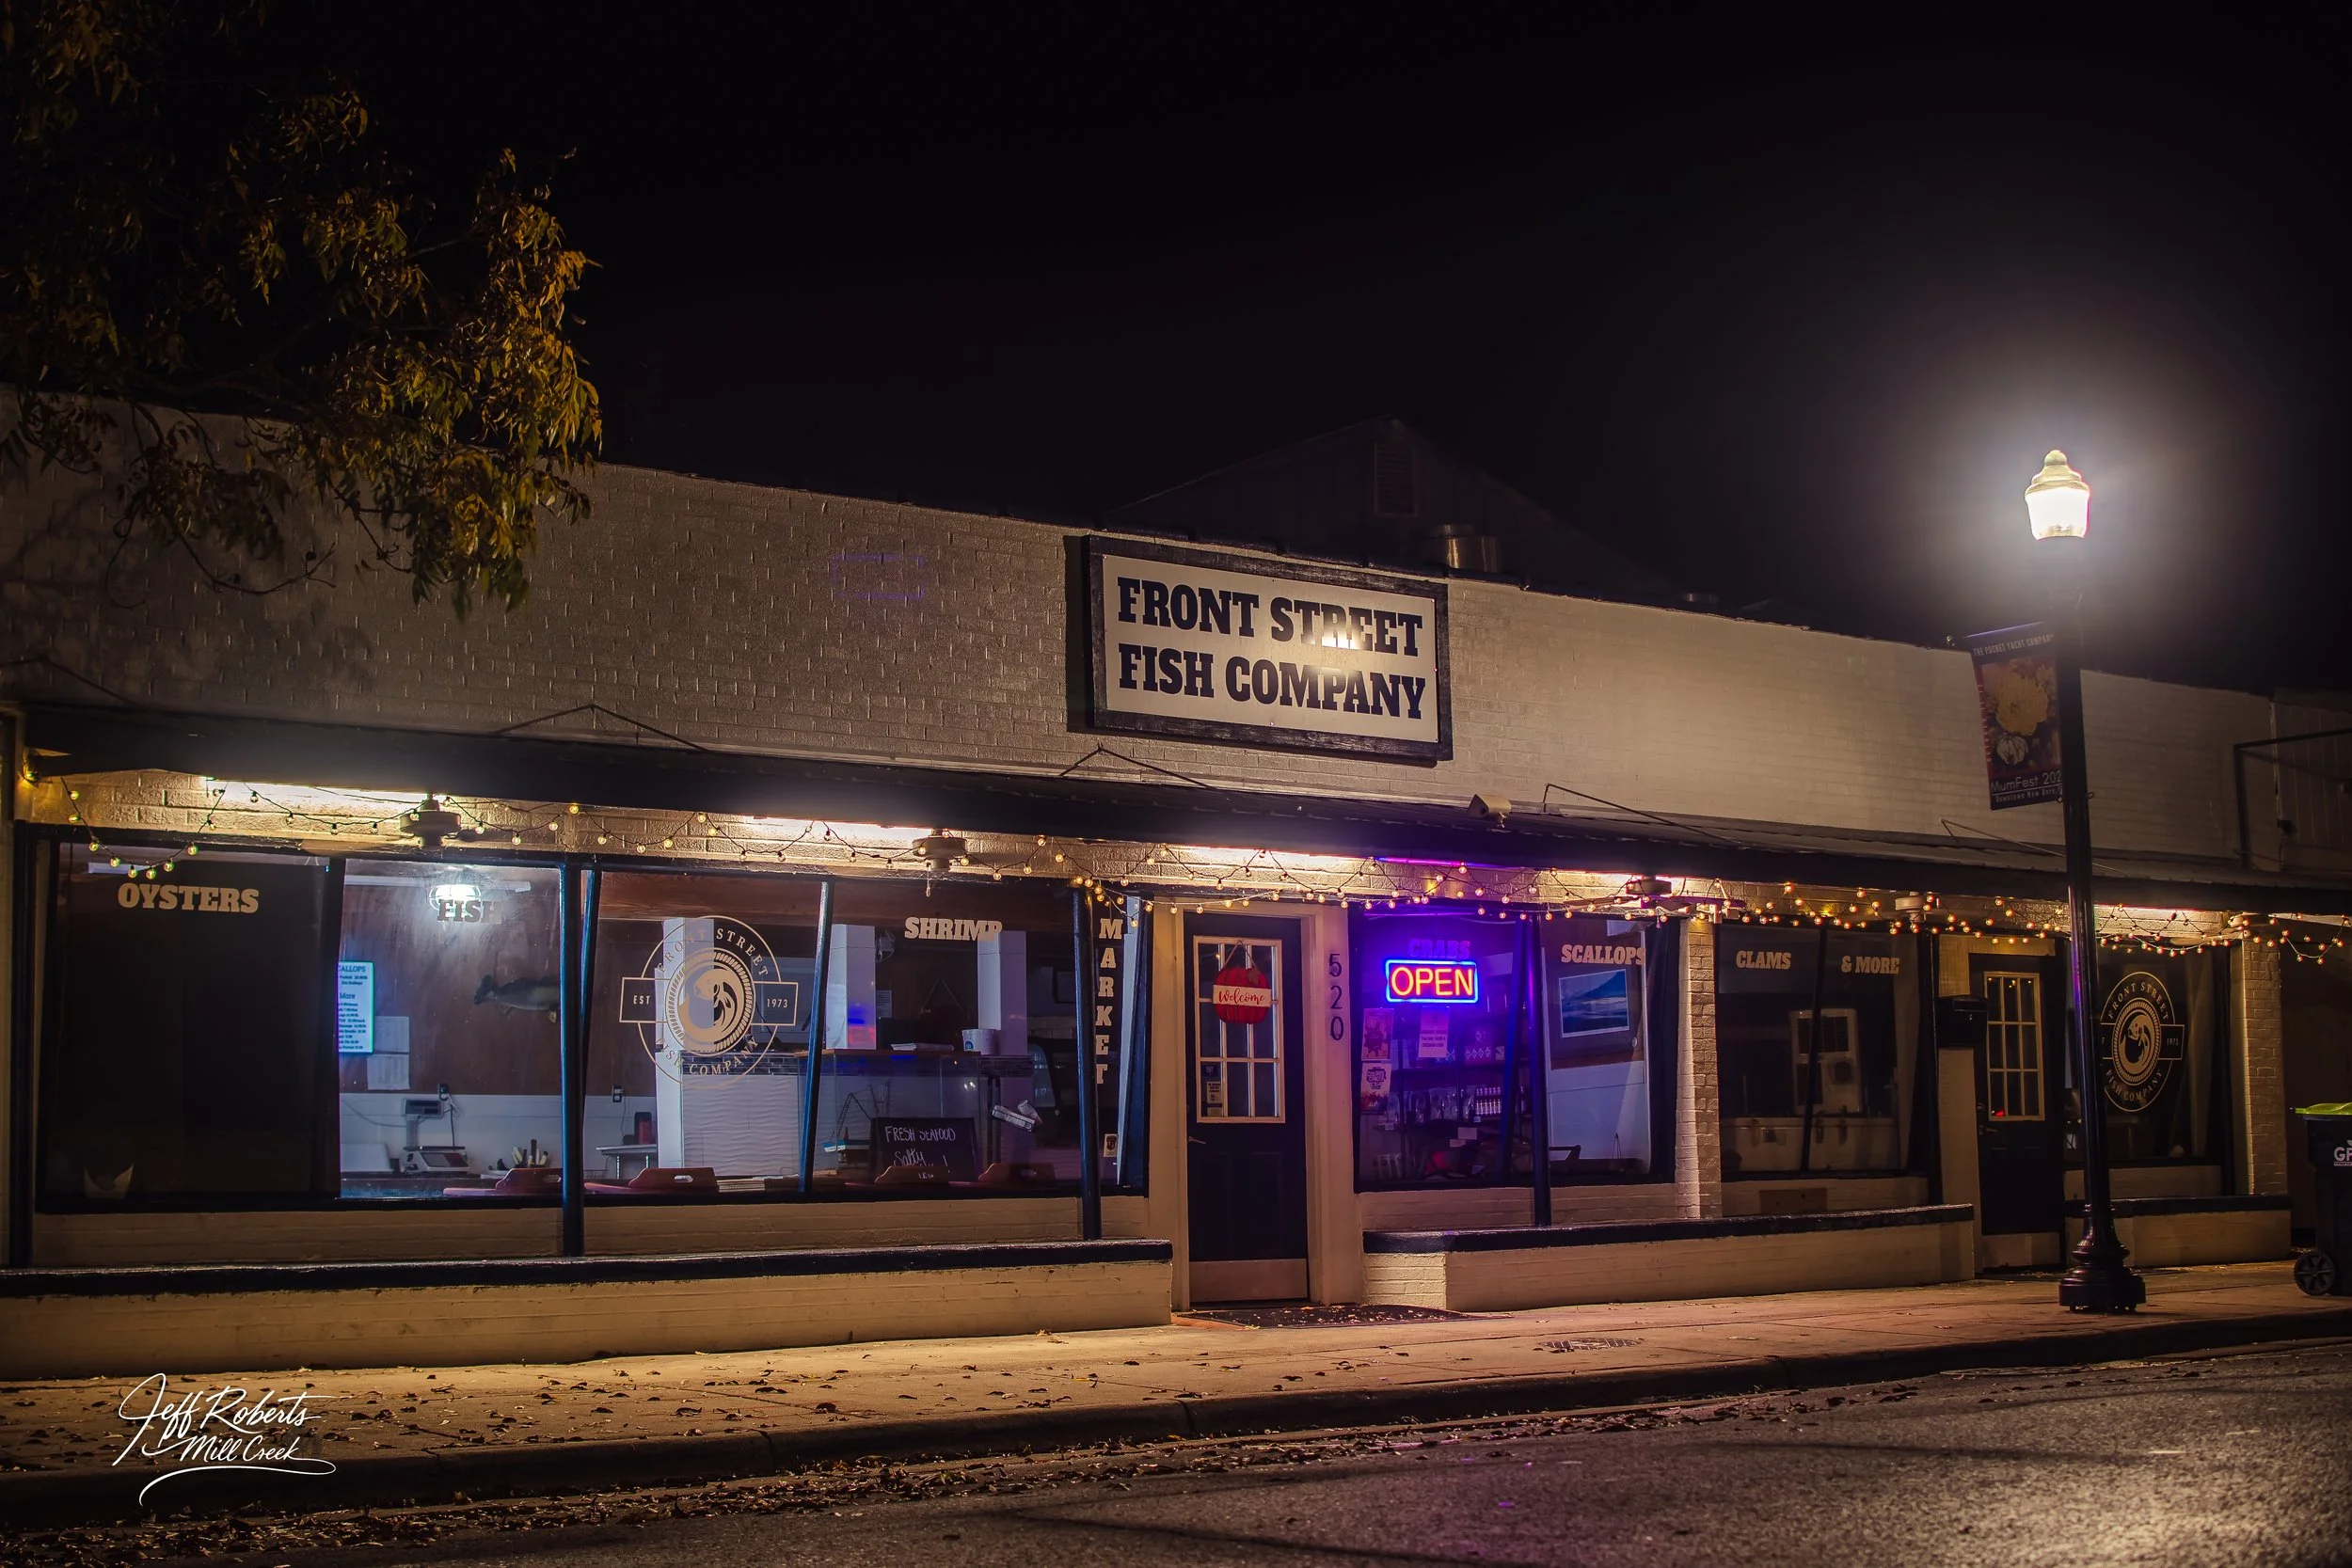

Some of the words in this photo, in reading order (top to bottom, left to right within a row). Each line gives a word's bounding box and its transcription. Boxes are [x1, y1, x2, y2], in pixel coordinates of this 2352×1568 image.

[1117, 576, 1260, 638] FRONT
[1270, 596, 1423, 657] STREET
[1973, 643, 1984, 657] THE
[1984, 641, 2006, 656] POCKET
[2007, 639, 2025, 651] YACHT
[1119, 642, 1215, 699] FISH
[1225, 656, 1426, 721] COMPANY
[1991, 775, 2039, 792] MumFest
[2043, 769, 2061, 785] 202
[118, 882, 260, 913] OYSTERS
[437, 898, 502, 925] FISH
[904, 916, 1003, 942] SHRIMP
[656, 928, 707, 974] FROT
[716, 927, 770, 977] STREET
[1561, 943, 1645, 966] SCALLOPS
[1736, 950, 1791, 971] CLAMS
[1840, 955, 1852, 973] &
[1854, 956, 1900, 975] MORE
[1391, 966, 1474, 997] OPEN
[633, 994, 651, 1006] EST
[767, 998, 788, 1008] 1973
[1095, 918, 1124, 1085] MARKET
[1218, 988, 1265, 1006] Welcome
[1328, 953, 1344, 1041] 520
[2108, 983, 2136, 1020] FRONT
[2140, 982, 2169, 1021] STREET
[656, 1037, 686, 1069] FISH
[689, 1036, 760, 1076] COMPANY
[2106, 1069, 2122, 1097] FISH
[2124, 1069, 2162, 1102] COMPANY
[884, 1125, 916, 1143] FRESH
[918, 1127, 957, 1142] SEAFOOD
[893, 1148, 928, 1167] Salty
